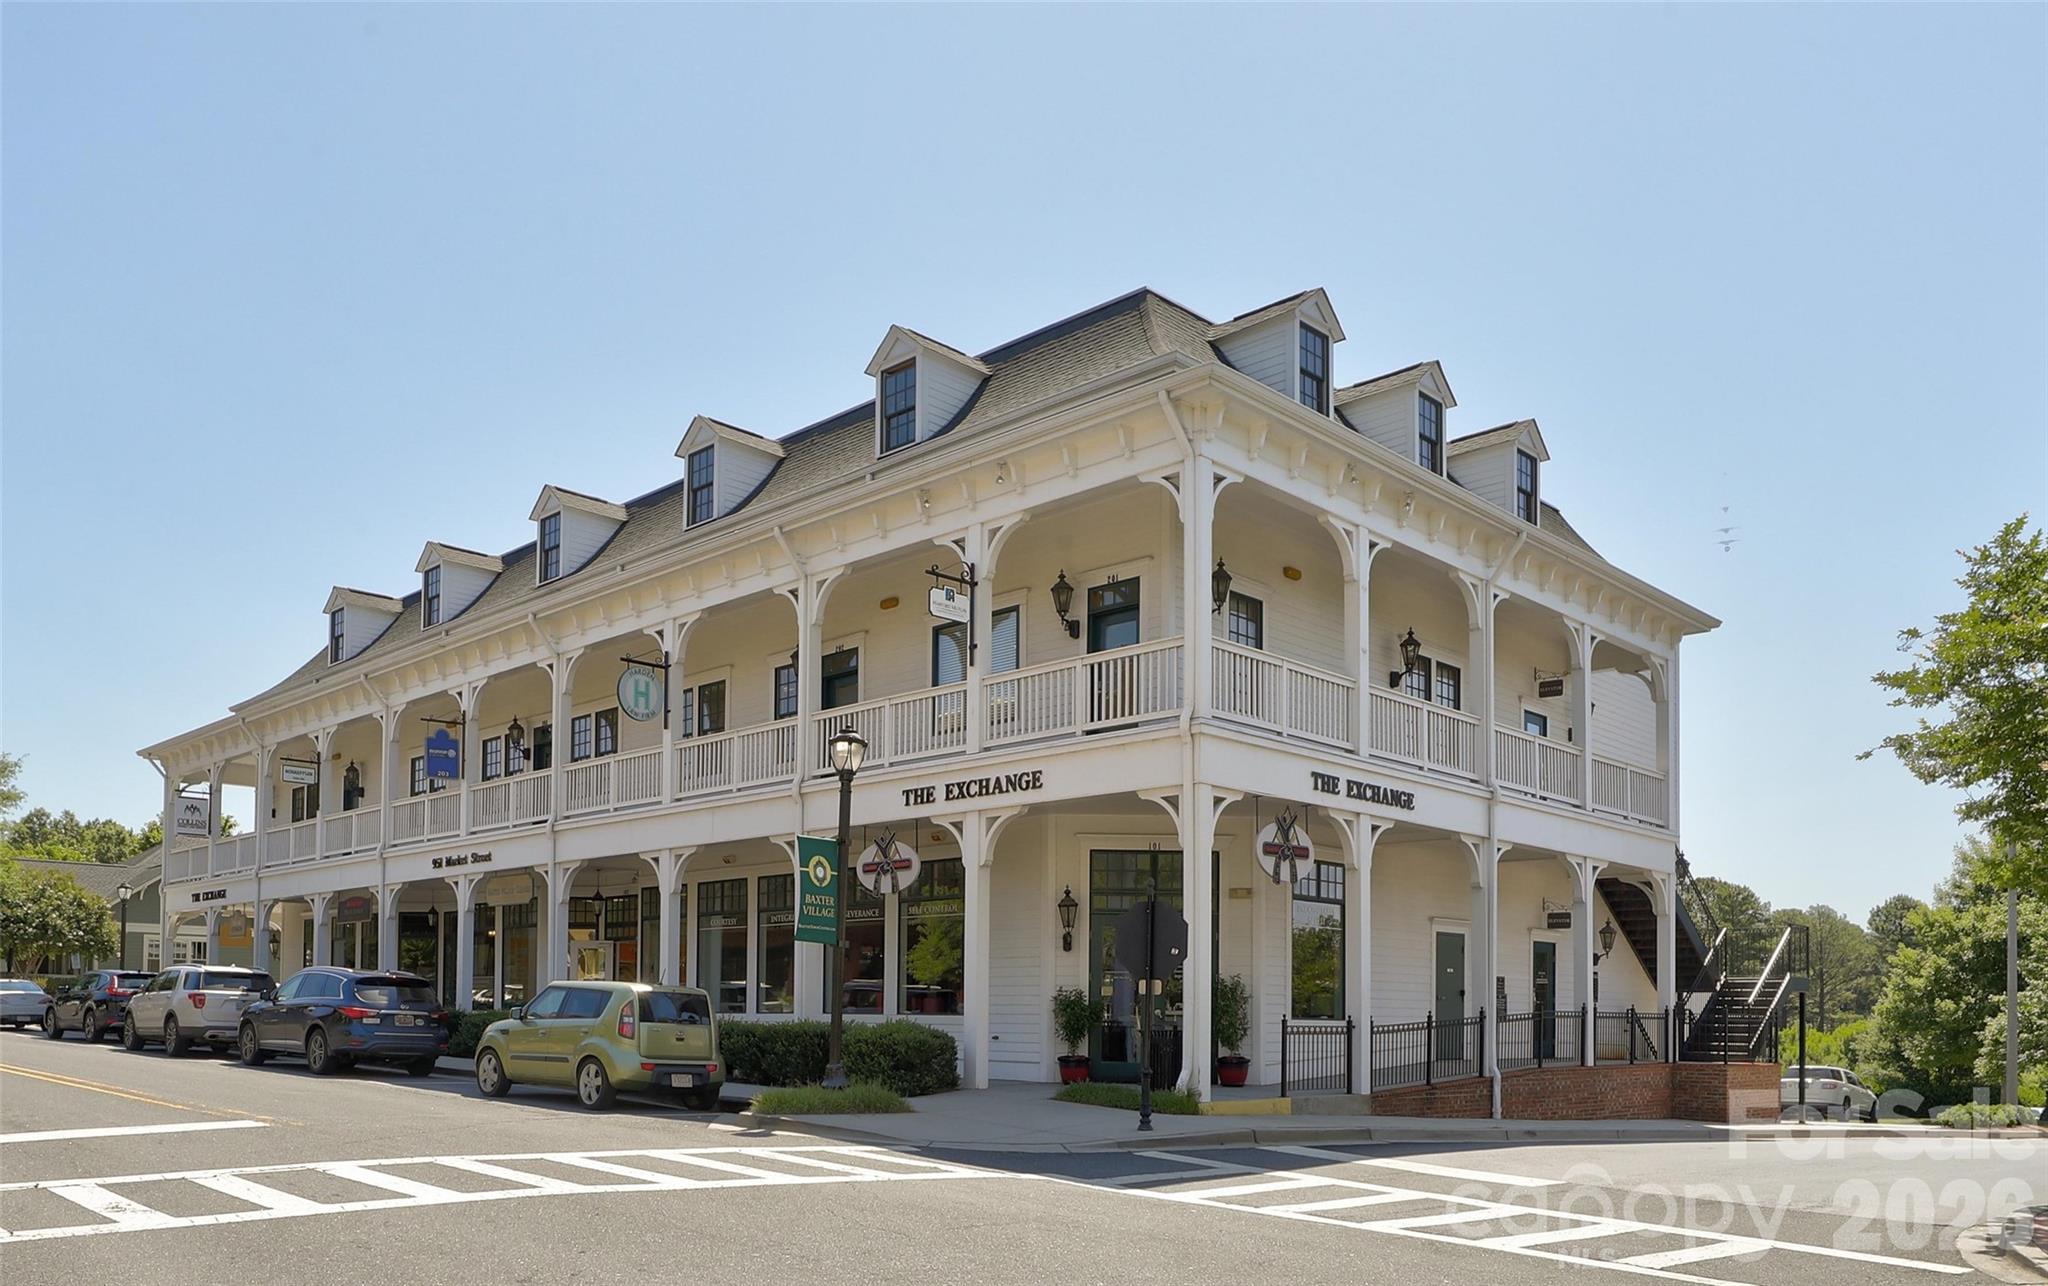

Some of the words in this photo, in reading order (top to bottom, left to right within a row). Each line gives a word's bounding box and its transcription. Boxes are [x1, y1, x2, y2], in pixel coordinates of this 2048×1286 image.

[633, 679, 650, 710] H
[902, 786, 936, 807] THE
[944, 770, 1043, 801] EXCHANGE
[1311, 771, 1341, 795] THE
[1346, 779, 1415, 811] EXCHANGE
[177, 818, 208, 827] COLLINS
[445, 855, 468, 868] Market
[471, 850, 493, 864] Street
[191, 893, 201, 903] THE
[202, 889, 227, 901] EXCHANGE
[805, 893, 835, 906] BAXTER
[803, 905, 835, 917] VILLAGE
[846, 908, 879, 918] EVERANCE
[908, 905, 922, 914] SELF
[924, 903, 958, 913] CONTROL
[710, 918, 737, 926] COURTESY
